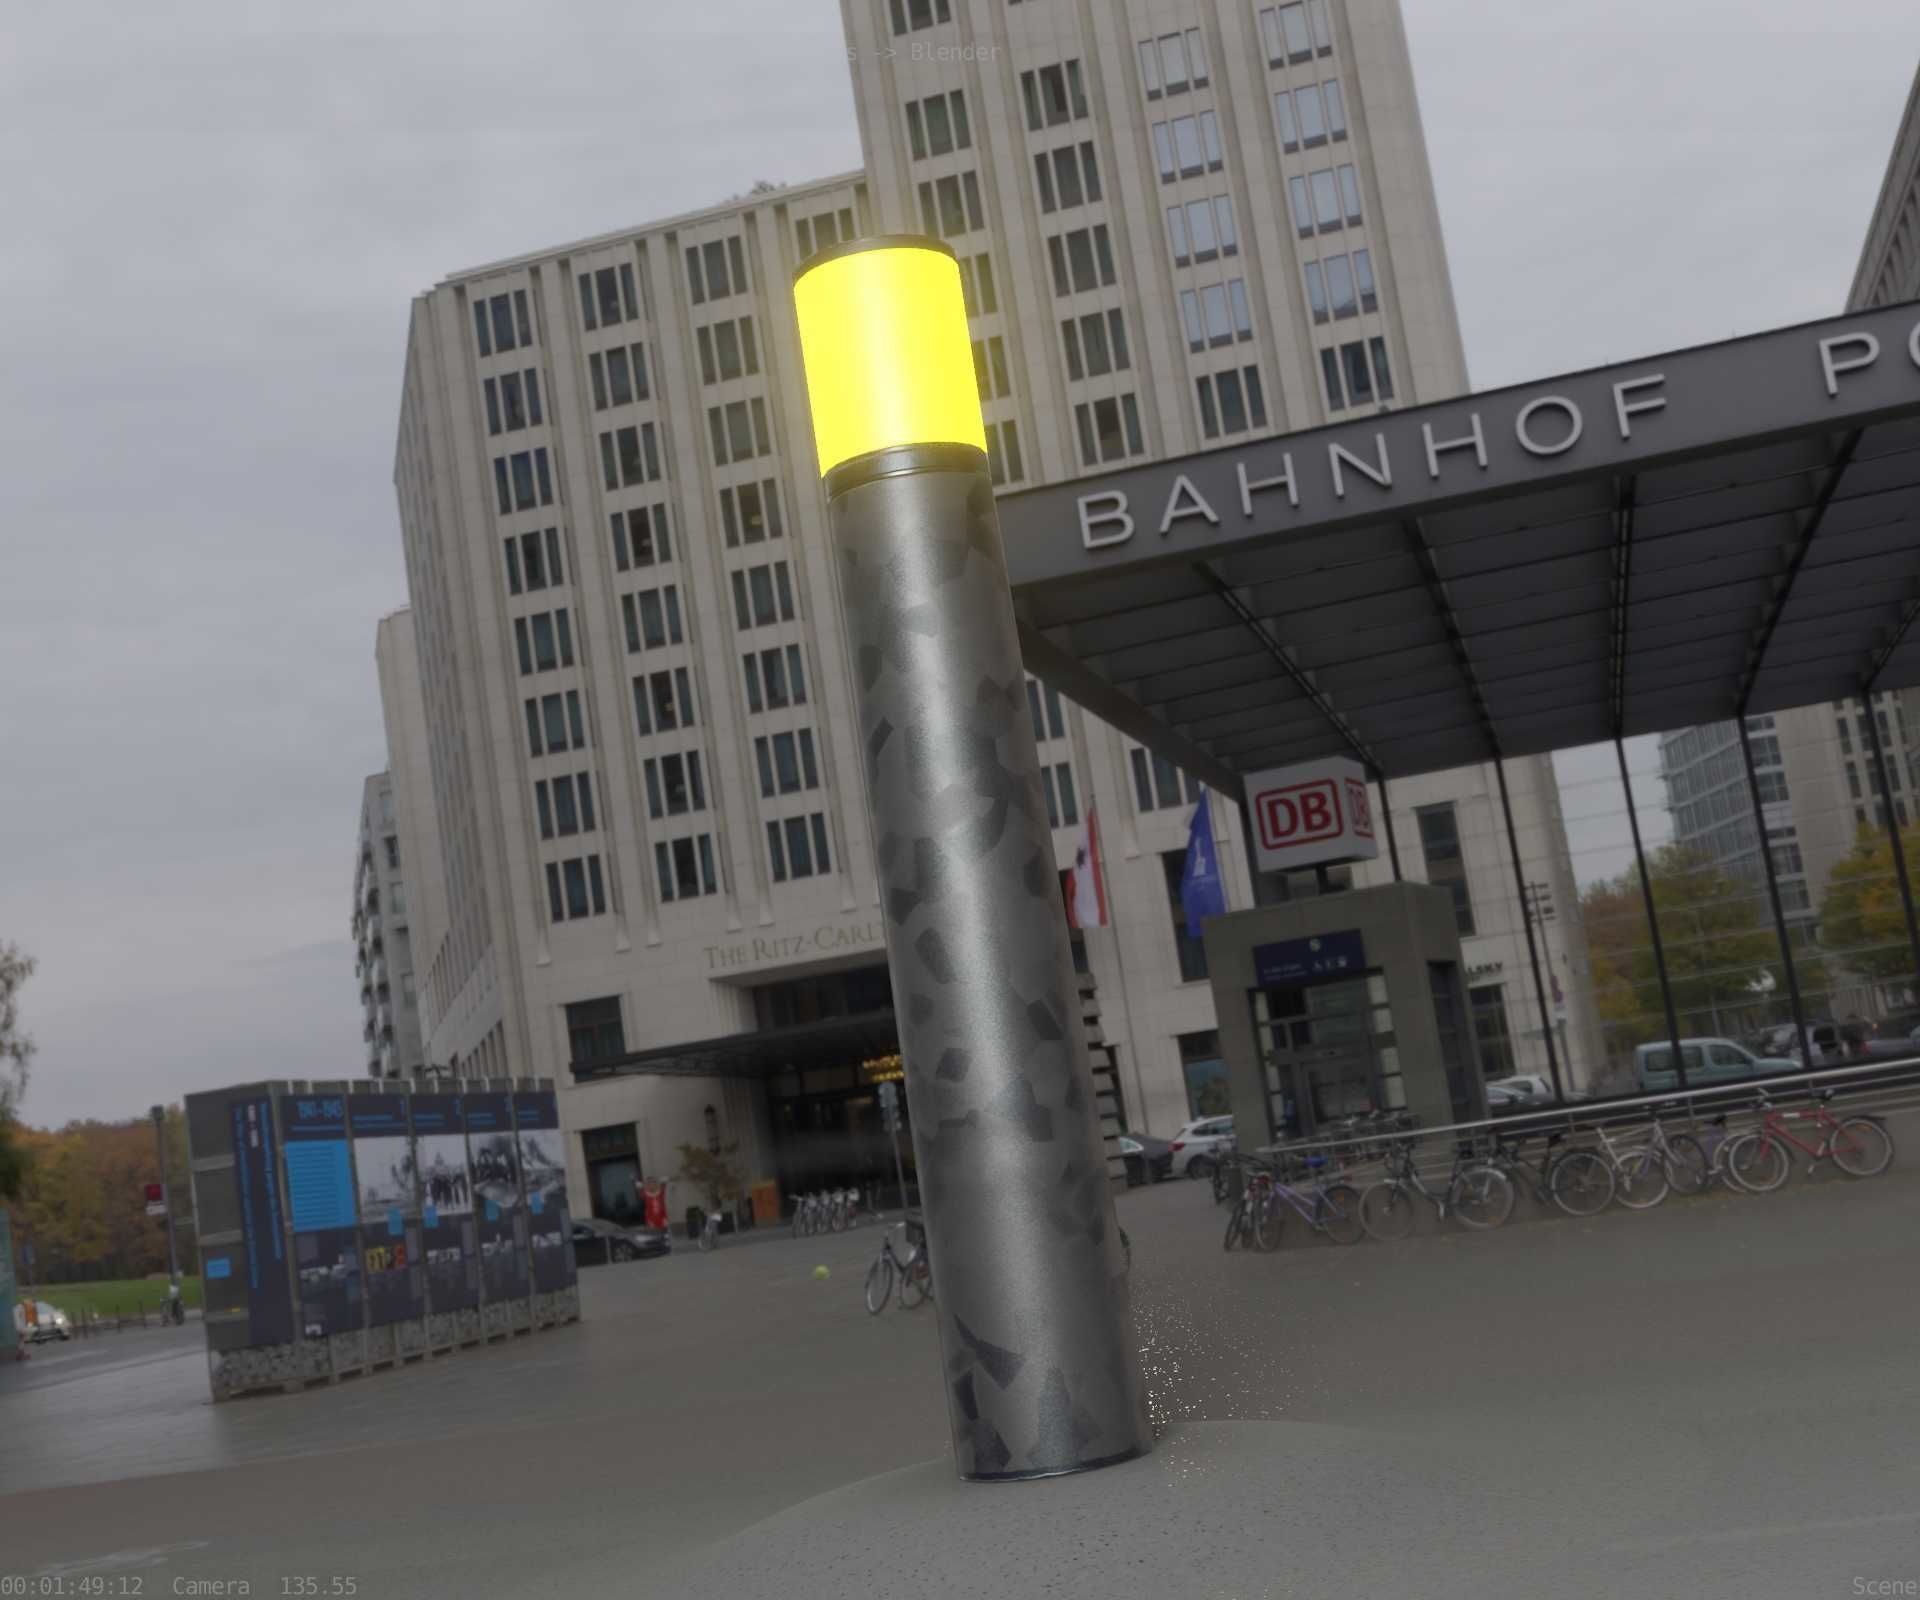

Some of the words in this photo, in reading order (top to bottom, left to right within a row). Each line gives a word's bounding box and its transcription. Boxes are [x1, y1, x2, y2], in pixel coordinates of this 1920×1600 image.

[1077, 373, 1666, 549] BAHNHOF
[1266, 790, 1332, 840] DB
[704, 946, 747, 969] THE
[752, 923, 882, 960] RITZ-CARL
